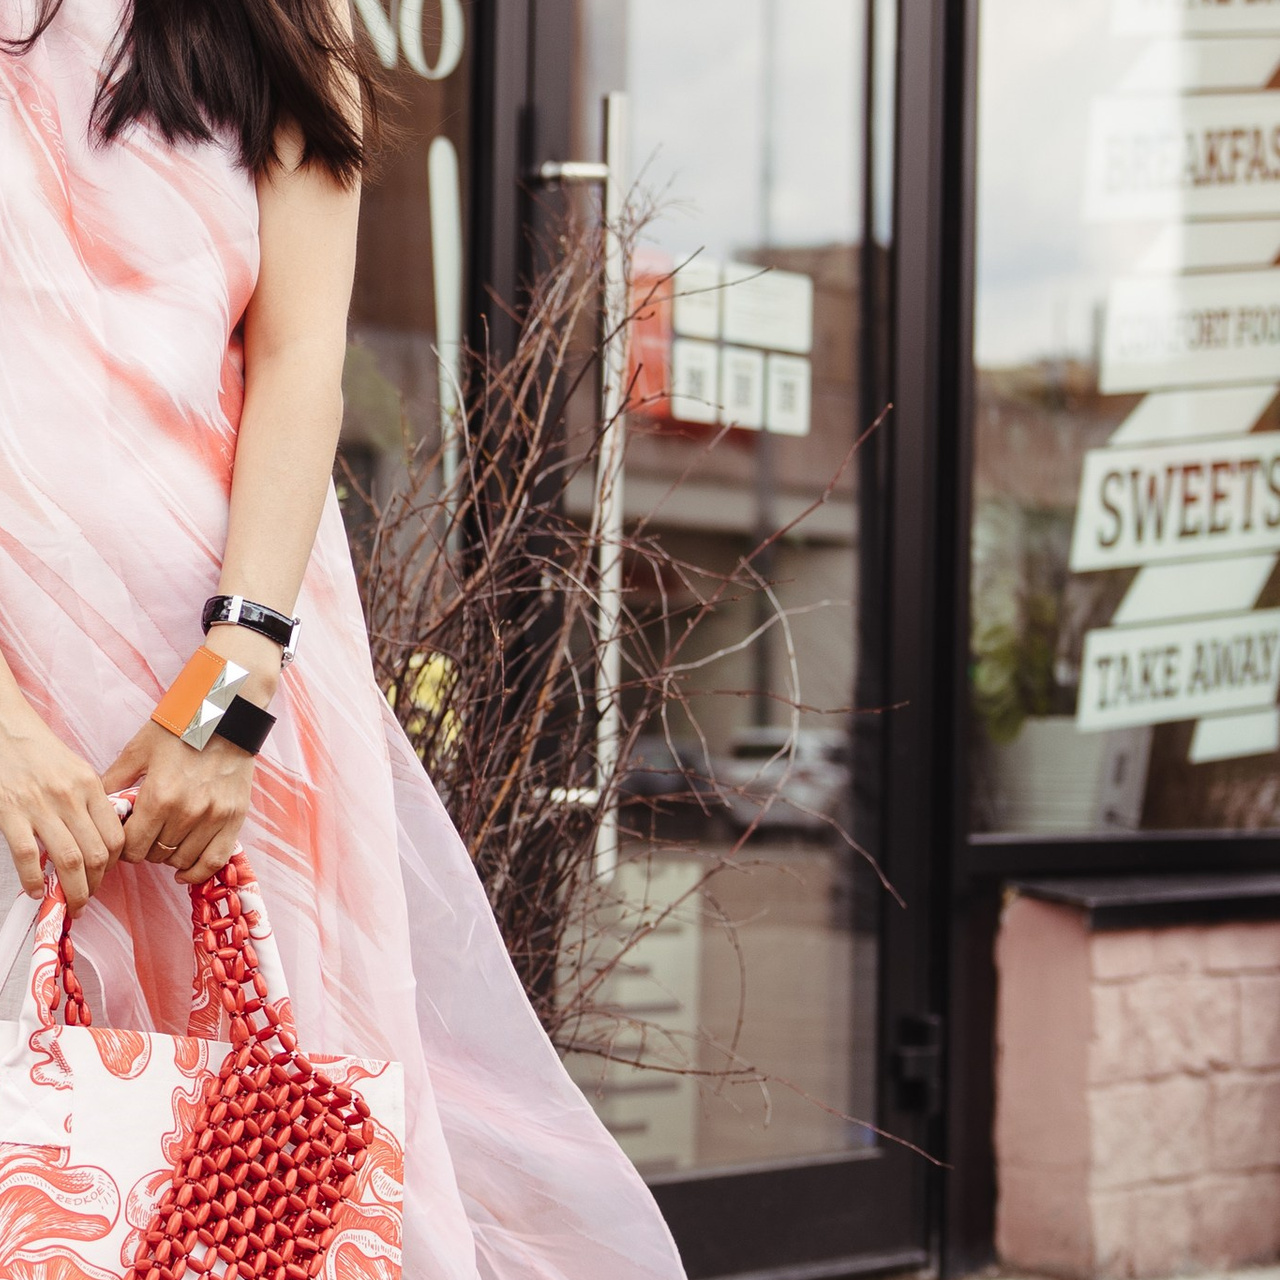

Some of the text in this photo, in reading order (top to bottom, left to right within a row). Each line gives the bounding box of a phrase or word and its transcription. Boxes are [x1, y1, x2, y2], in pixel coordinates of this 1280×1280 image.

[1095, 633, 1278, 709] TAKE AWAY
[55, 1185, 106, 1206] REDKOE
